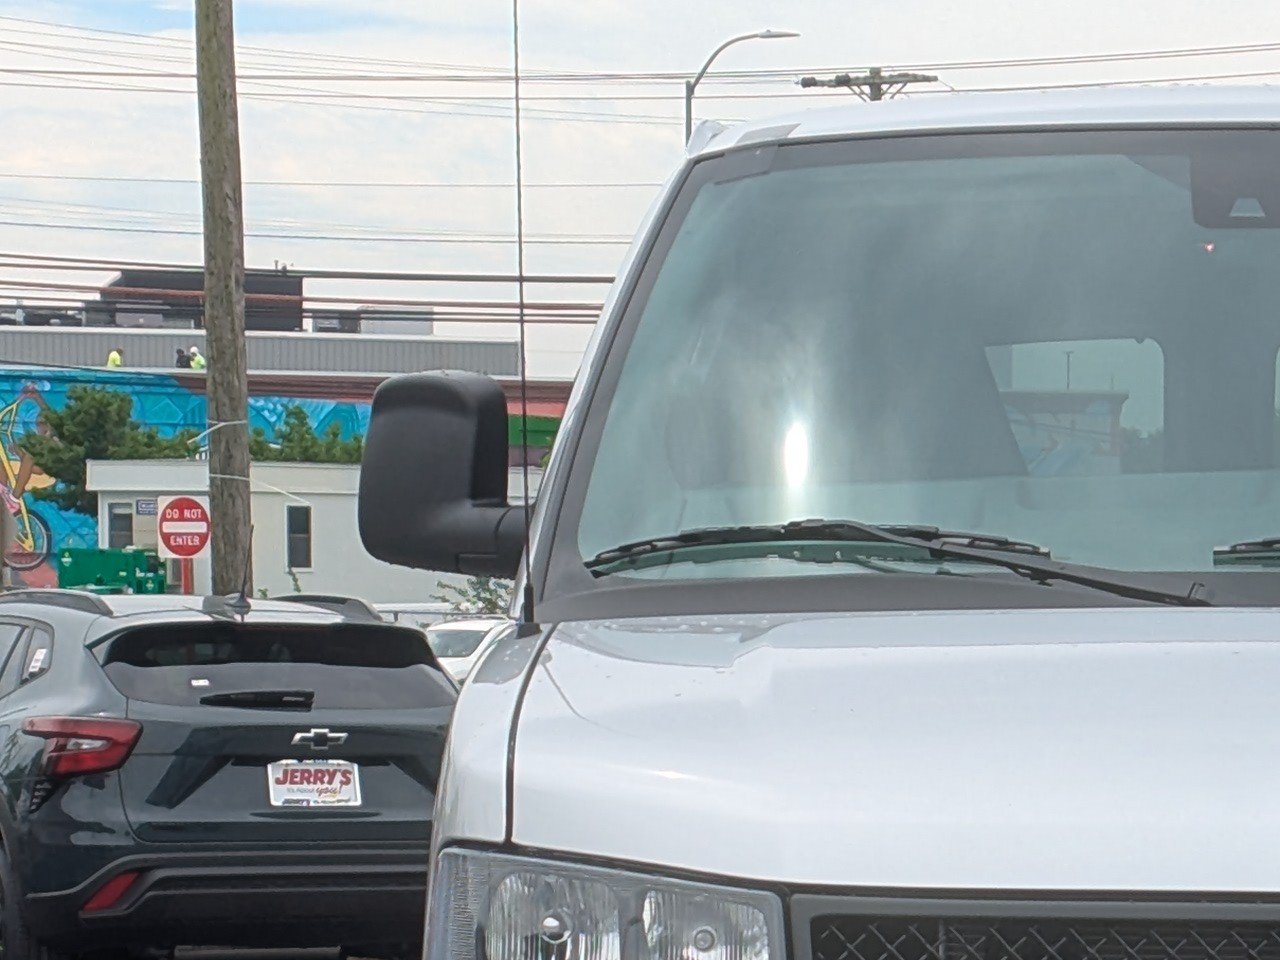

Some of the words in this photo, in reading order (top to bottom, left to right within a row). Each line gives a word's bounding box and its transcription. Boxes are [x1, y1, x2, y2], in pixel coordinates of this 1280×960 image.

[165, 508, 180, 519] DO
[183, 508, 202, 519] NOT
[169, 535, 200, 546] ENTER
[275, 768, 353, 786] JERRY'S
